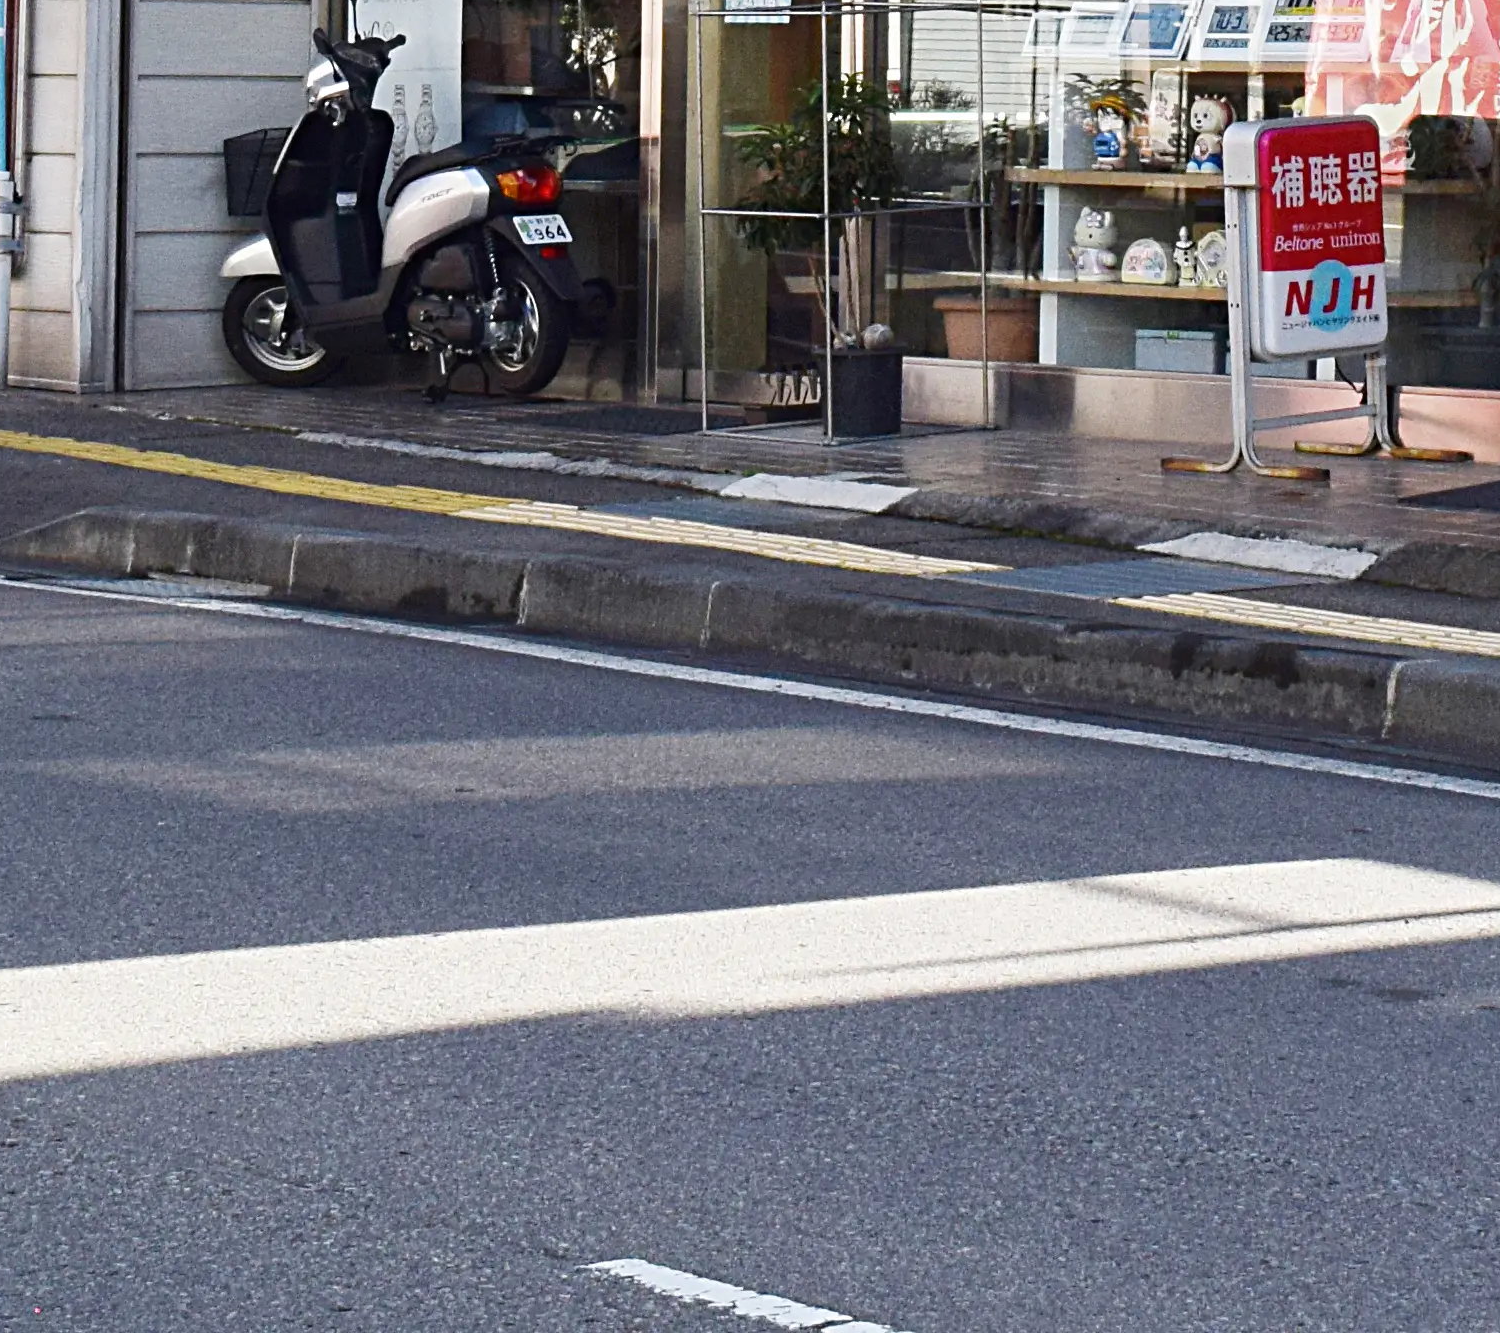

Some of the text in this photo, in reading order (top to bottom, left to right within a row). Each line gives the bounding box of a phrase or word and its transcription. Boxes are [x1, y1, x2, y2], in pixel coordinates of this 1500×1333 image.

[1271, 152, 1379, 209] 補聴器
[534, 225, 567, 240] 964
[1274, 230, 1381, 252] Beltone unitron
